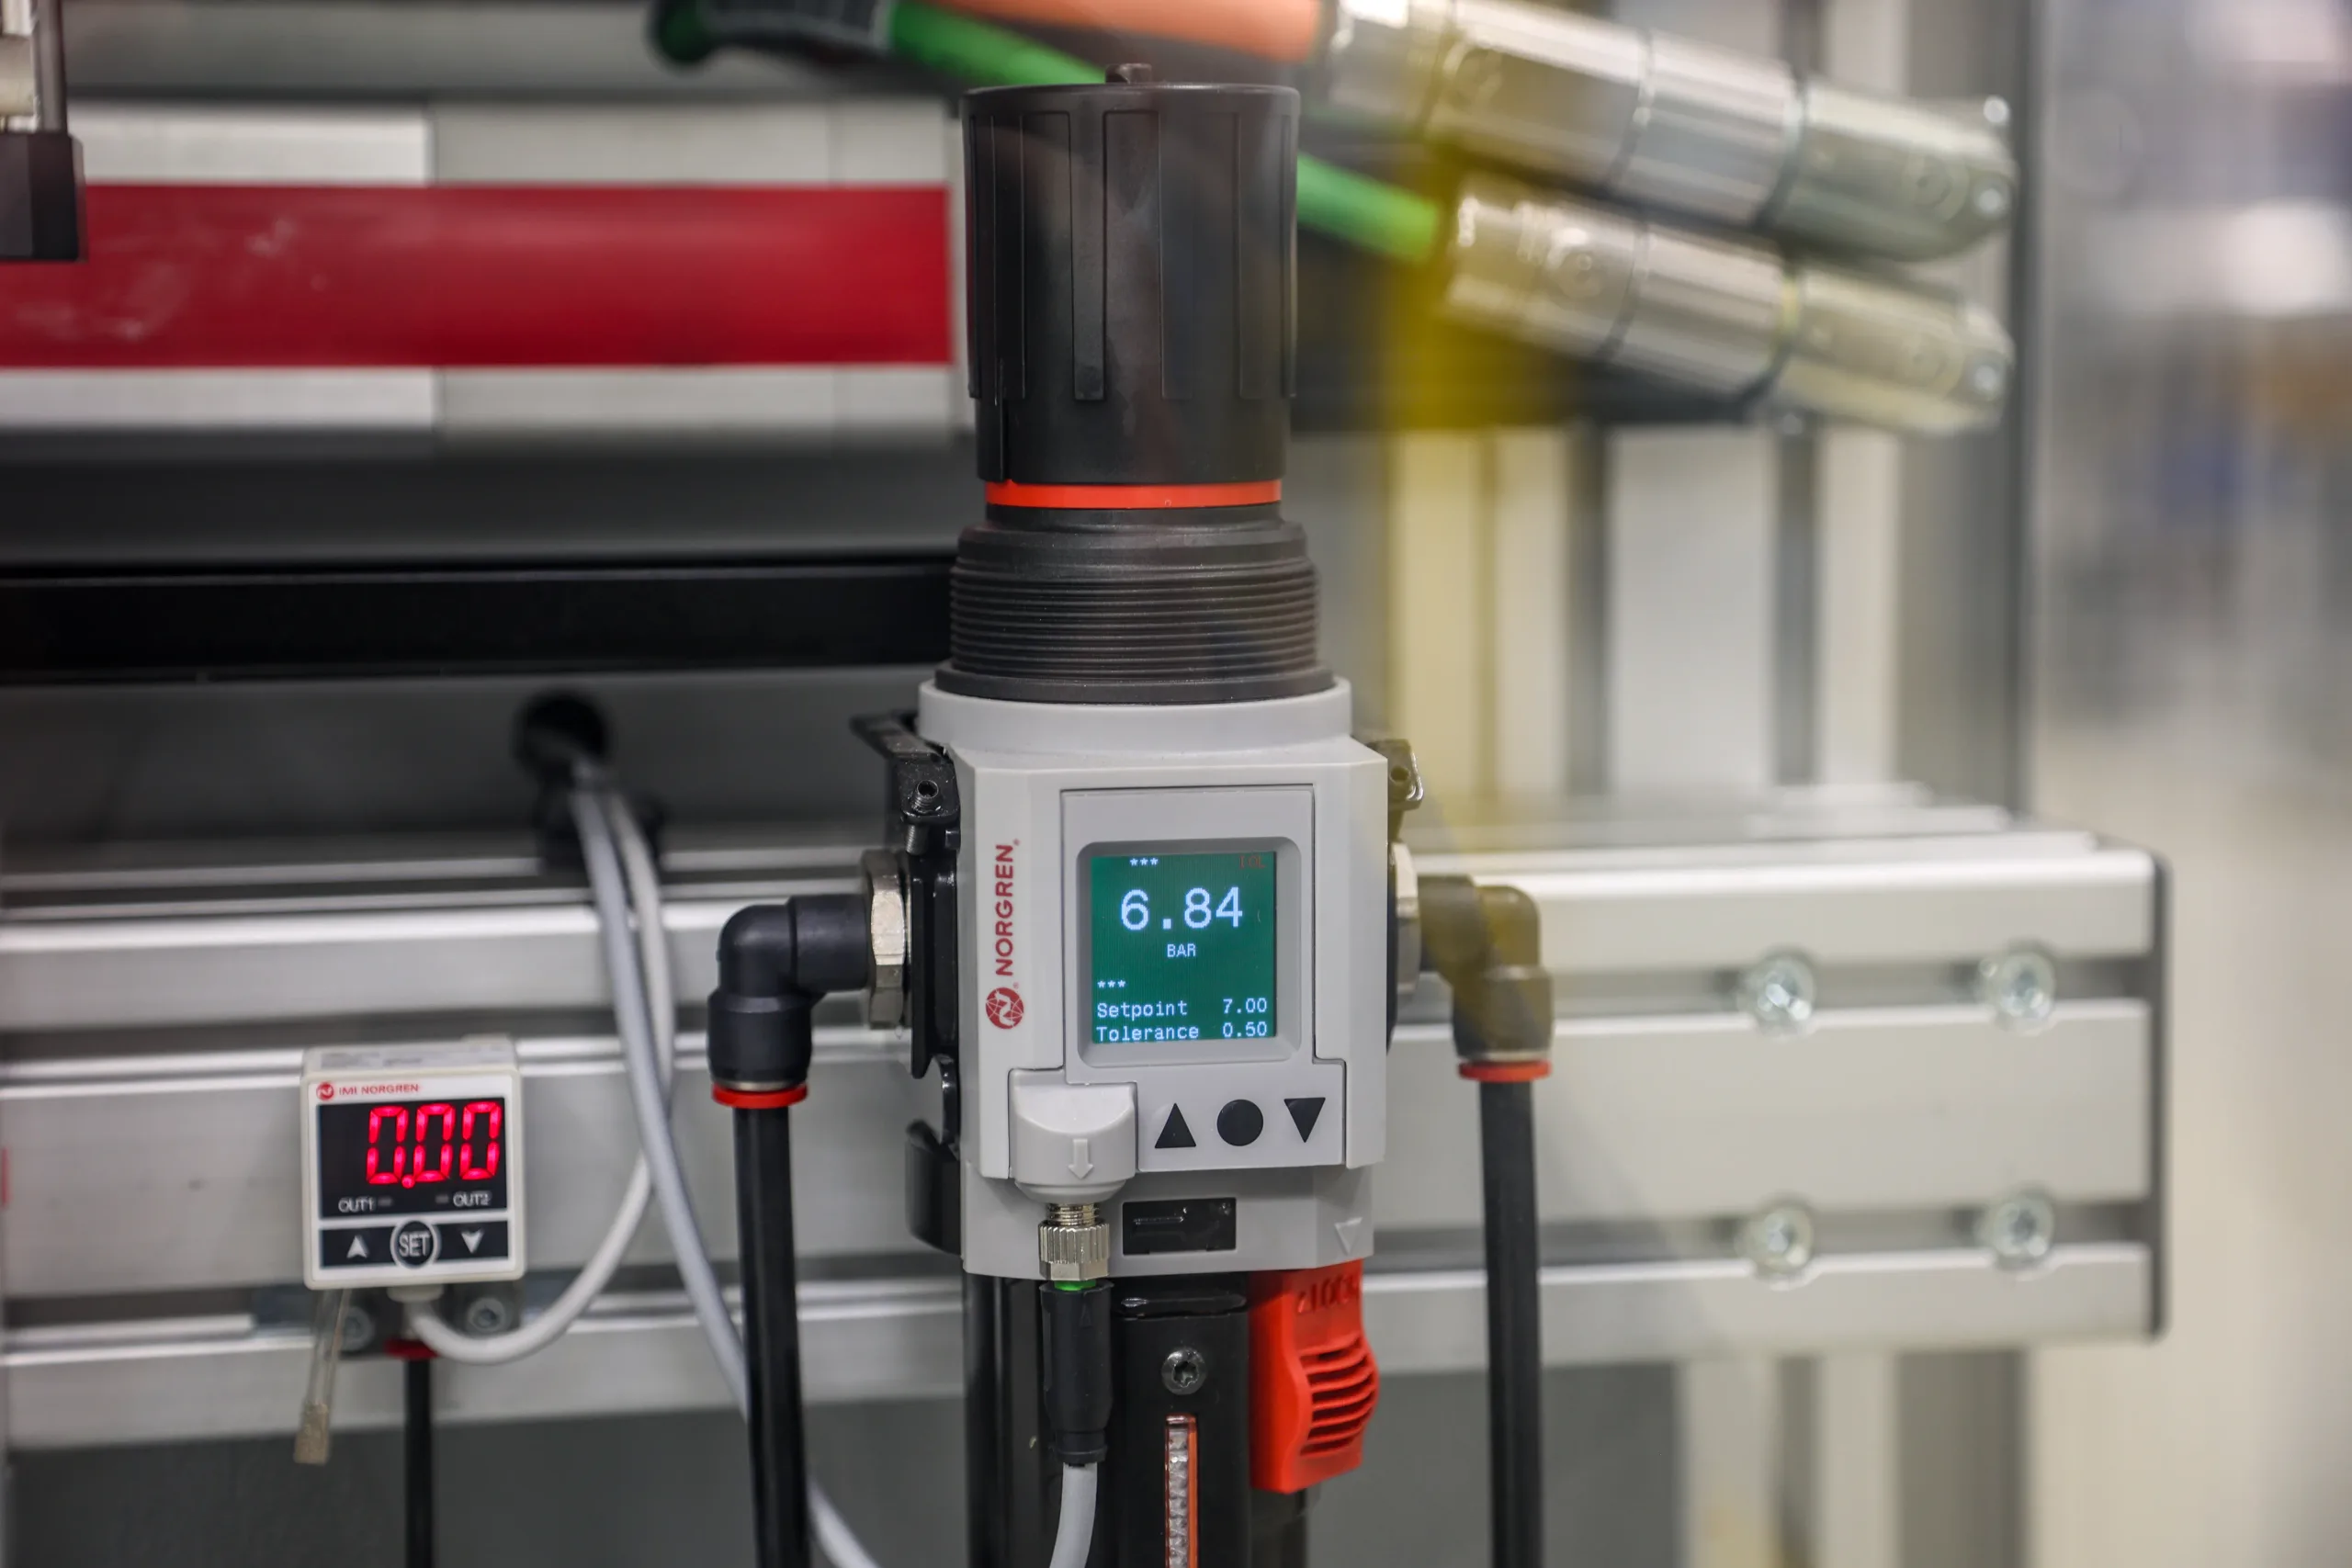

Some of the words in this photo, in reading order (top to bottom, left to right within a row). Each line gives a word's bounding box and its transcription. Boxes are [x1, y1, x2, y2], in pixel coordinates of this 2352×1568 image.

[995, 844, 1013, 976] NORGREN
[1120, 886, 1243, 931] 6.84
[1167, 943, 1196, 957] BAR
[1097, 1000, 1188, 1021] Setpoint
[1223, 998, 1267, 1014] 7.00
[1096, 1025, 1199, 1042] Tolerance
[1223, 1021, 1267, 1037] 0.50
[339, 1086, 357, 1096] IMI
[361, 1083, 419, 1096] NORGREN
[367, 1101, 502, 1189] 0.00
[338, 1196, 376, 1213] OUT1
[453, 1190, 492, 1208] OUT2
[399, 1231, 430, 1258] SET
